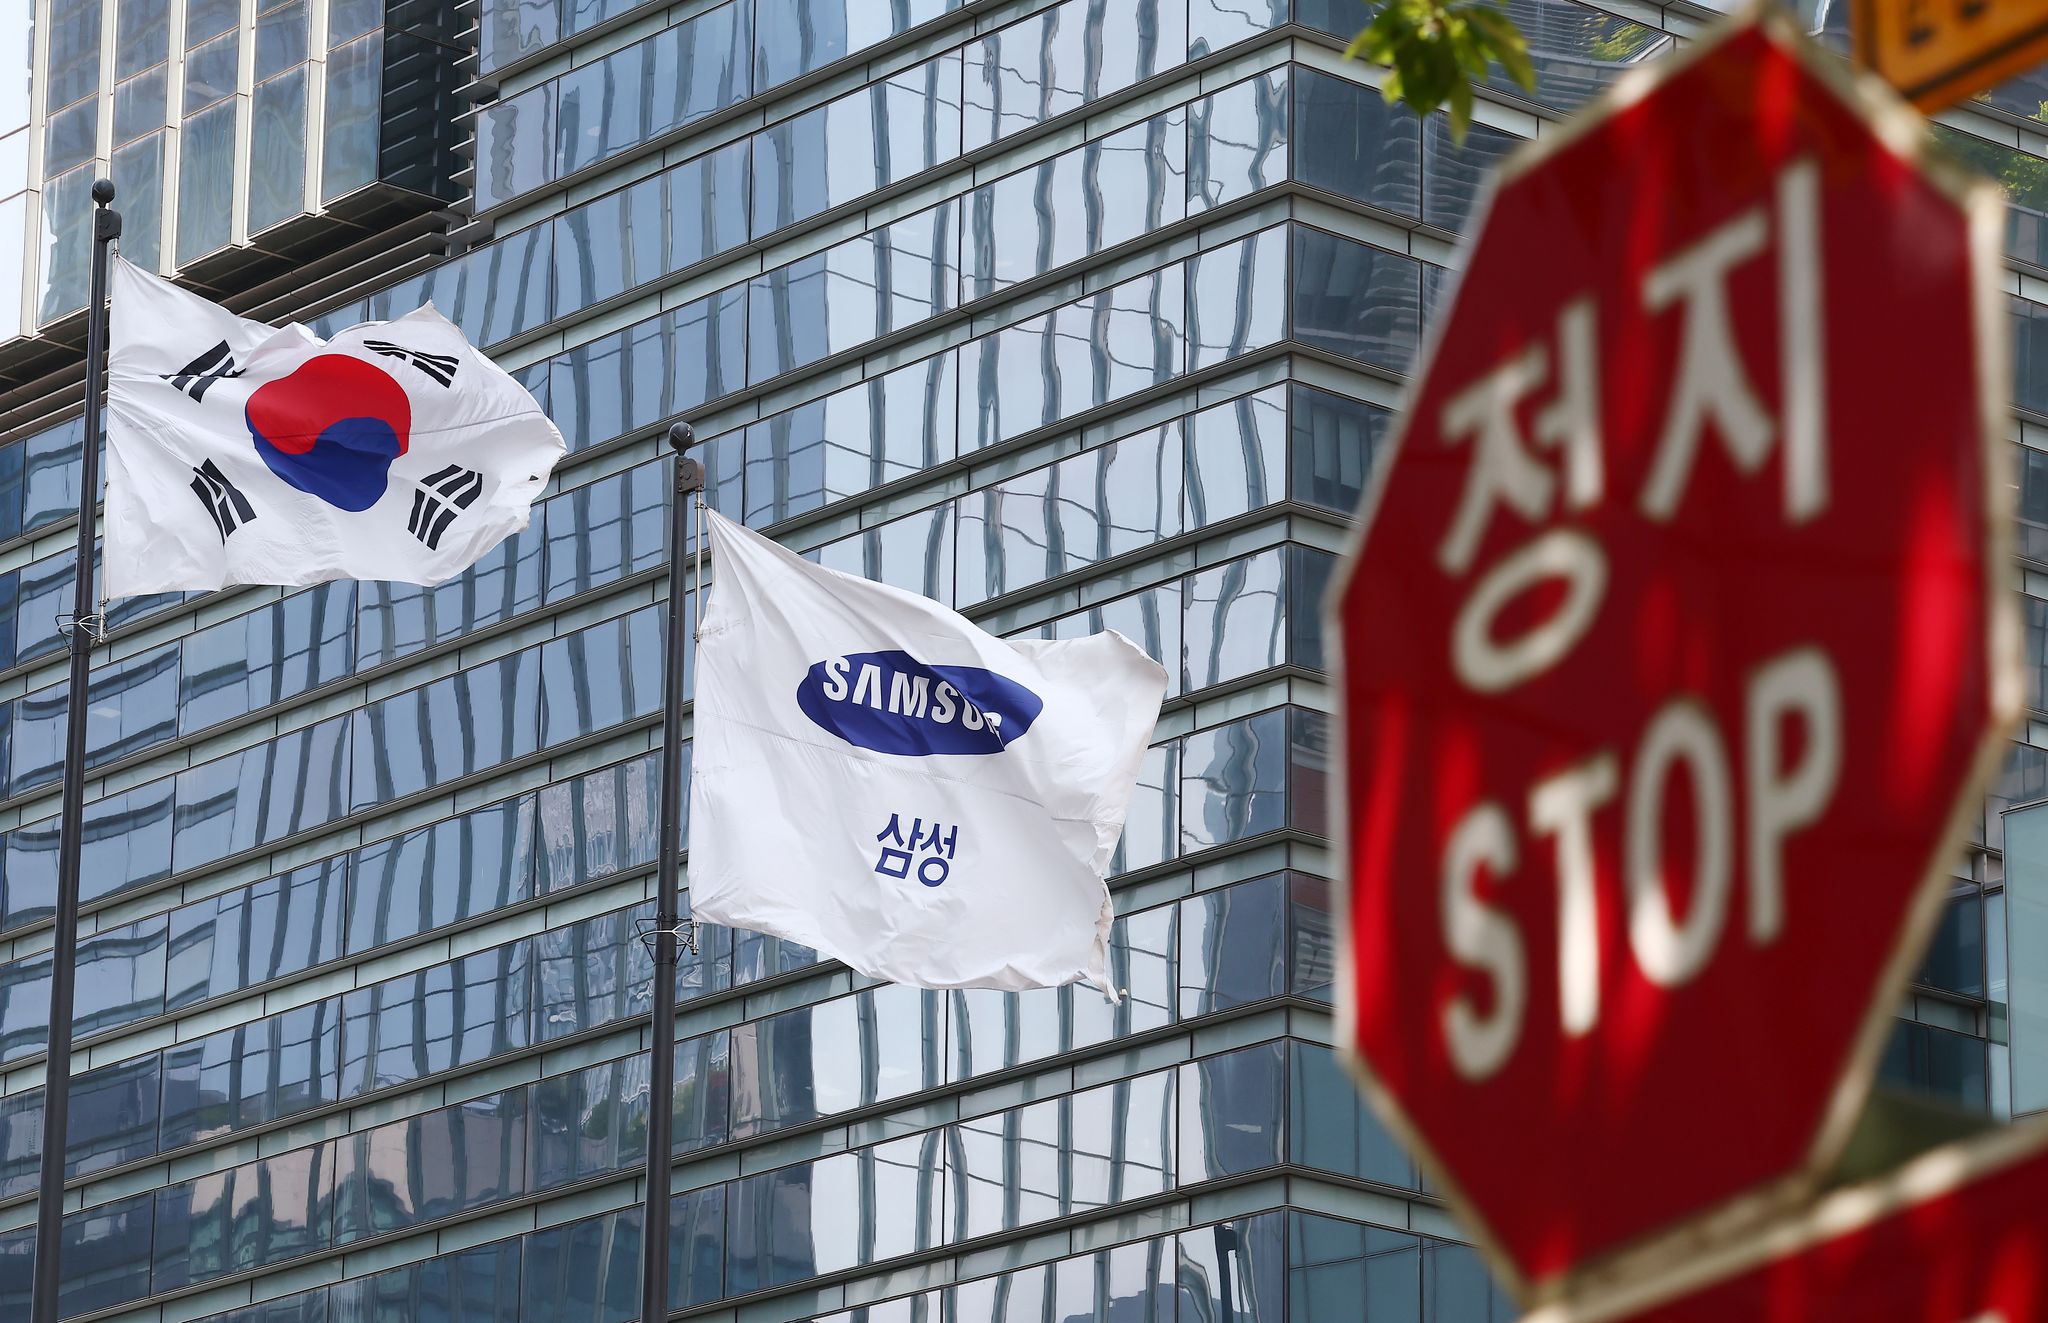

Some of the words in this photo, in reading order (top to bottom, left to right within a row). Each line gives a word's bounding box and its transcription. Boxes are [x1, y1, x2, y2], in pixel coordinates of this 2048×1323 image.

[1438, 157, 1830, 692] 정지
[823, 656, 1002, 734] SAMSU
[874, 812, 958, 888] 삼성
[1440, 645, 1842, 1081] STOP
